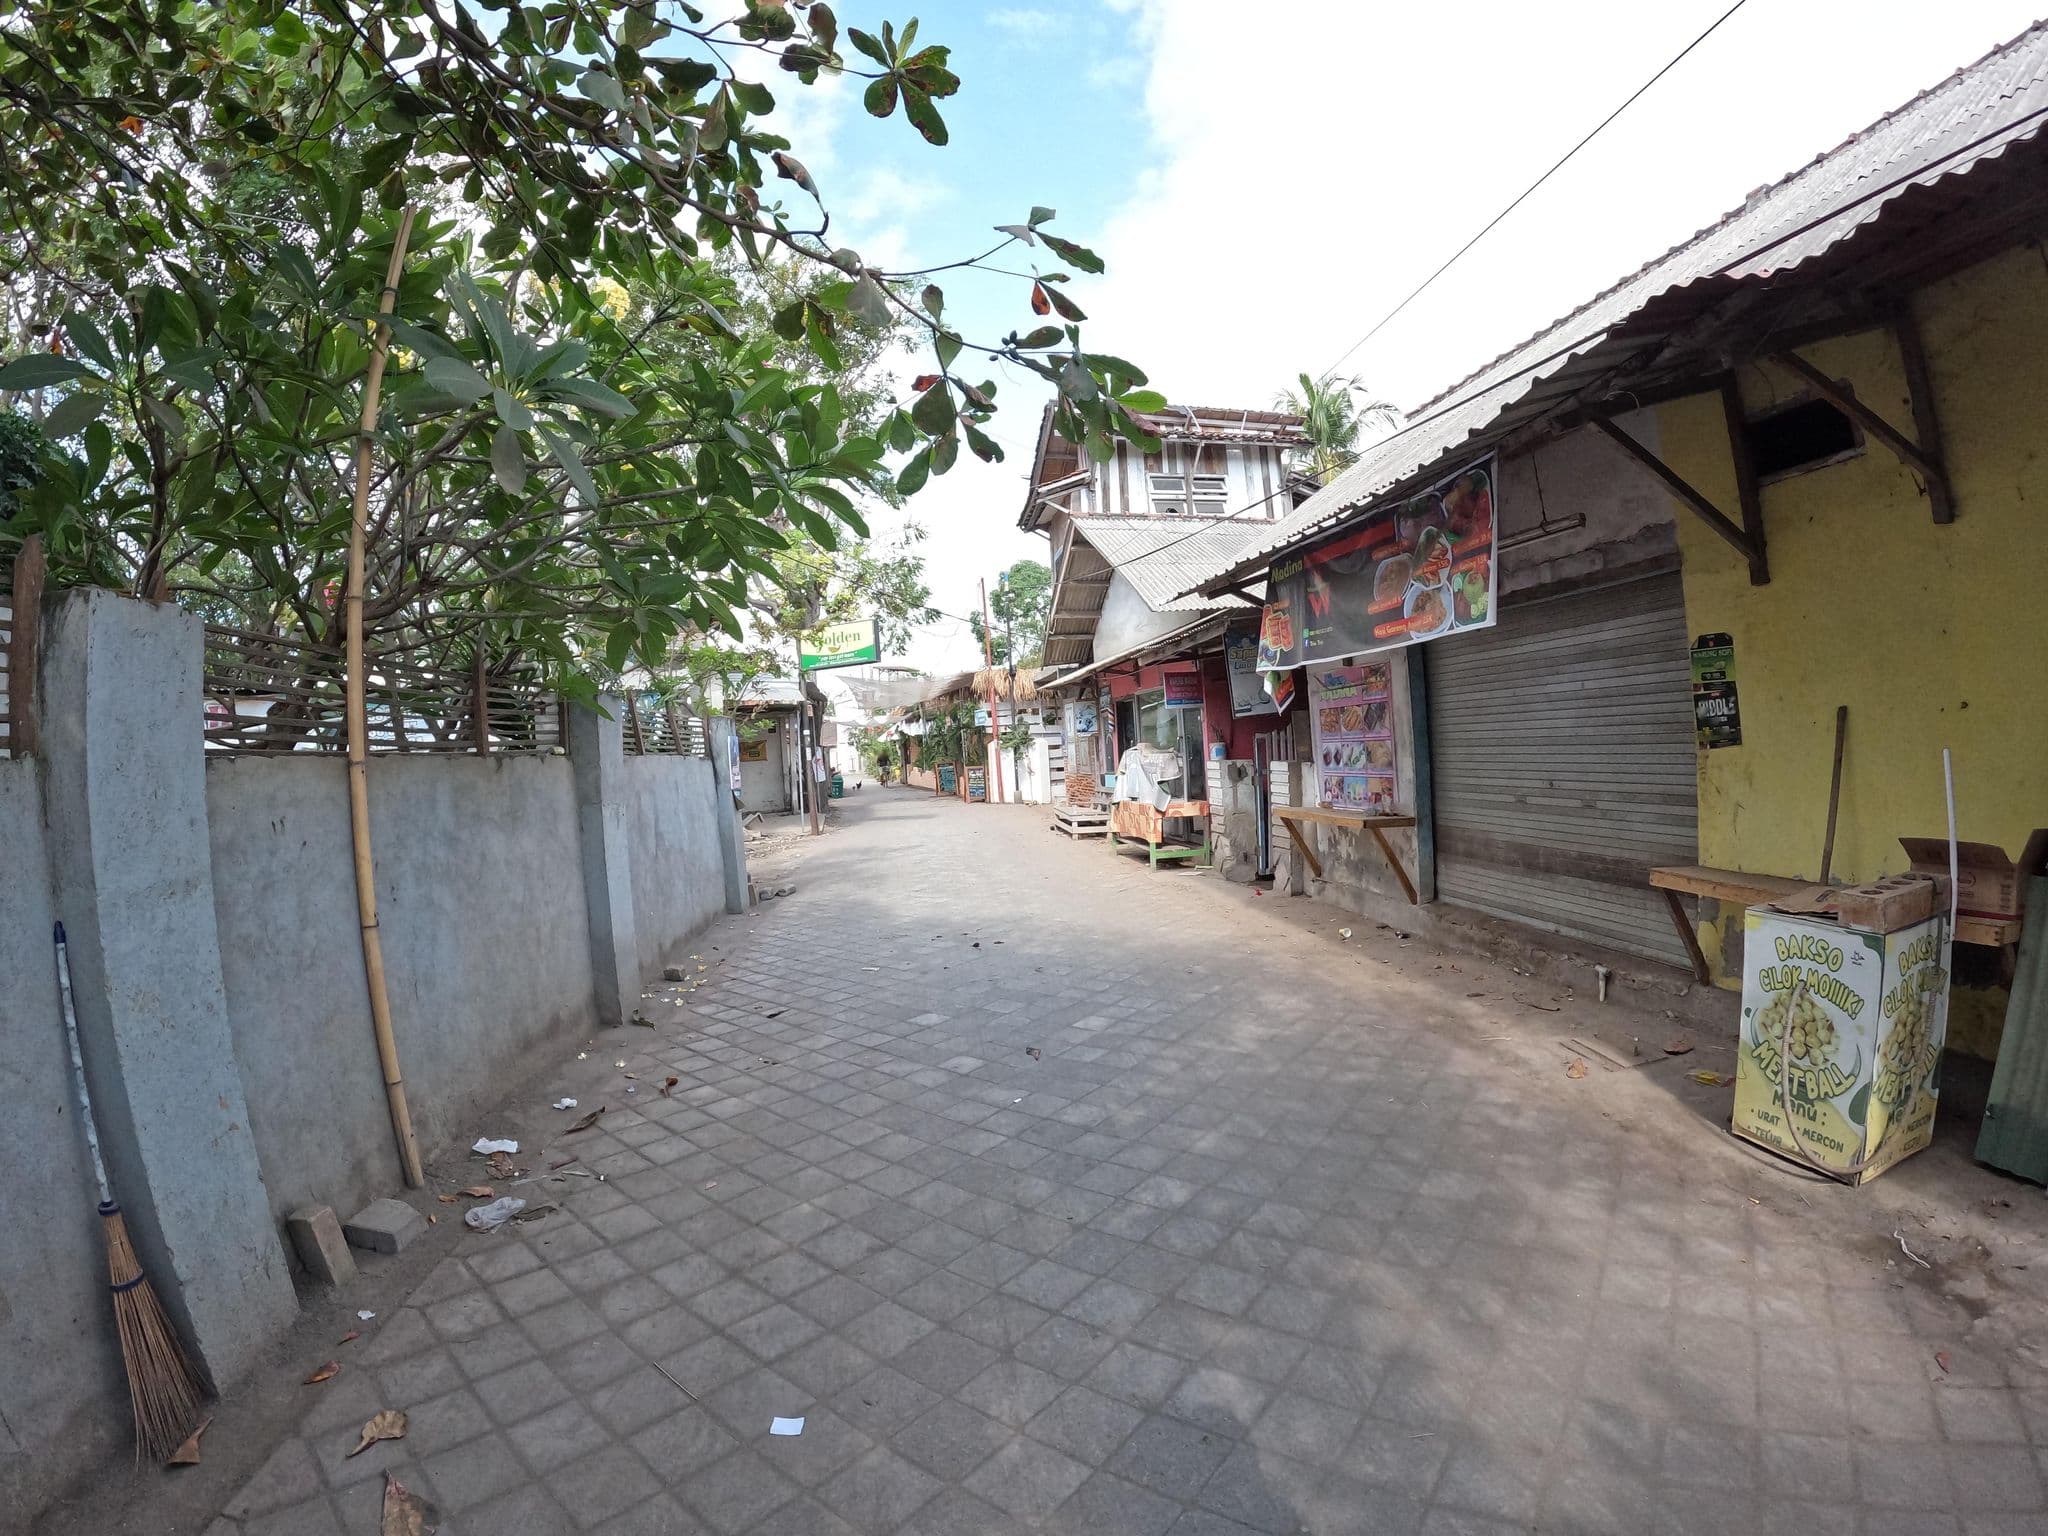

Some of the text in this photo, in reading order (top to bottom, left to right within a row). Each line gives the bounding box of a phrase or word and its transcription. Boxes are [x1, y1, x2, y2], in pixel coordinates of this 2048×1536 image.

[1775, 934, 1844, 972] BAKSO
[1759, 964, 1802, 993] CILOK
[1757, 1109, 1781, 1126] URAT
[1801, 1127, 1845, 1153] MERCON
